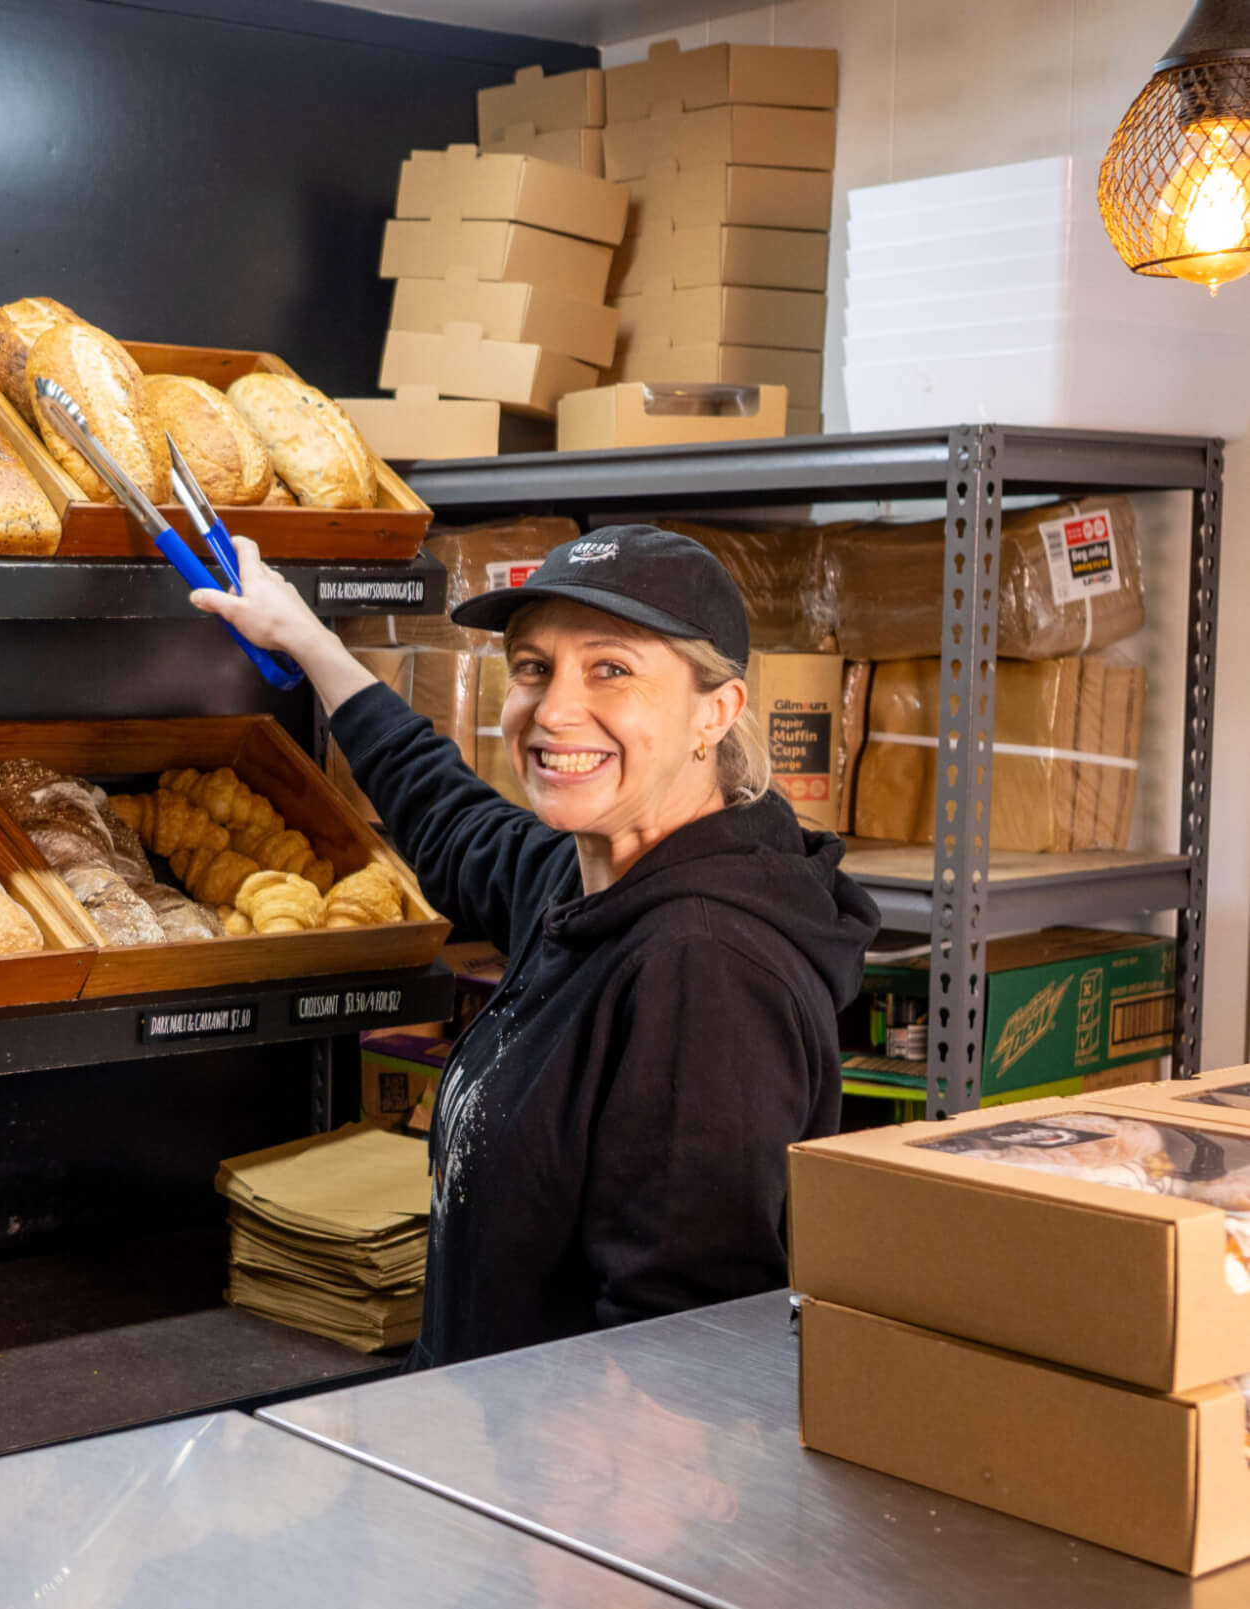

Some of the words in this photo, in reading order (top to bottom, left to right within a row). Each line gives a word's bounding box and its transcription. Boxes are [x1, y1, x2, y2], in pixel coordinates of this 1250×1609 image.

[774, 699, 828, 712] Gilmours
[773, 717, 804, 730] Paper
[773, 730, 817, 742] Muffin
[772, 744, 807, 759] Cups
[771, 760, 802, 771] Large
[299, 994, 339, 1018] CROISSANT
[151, 1016, 170, 1035] DARK
[169, 1013, 188, 1034] MALT
